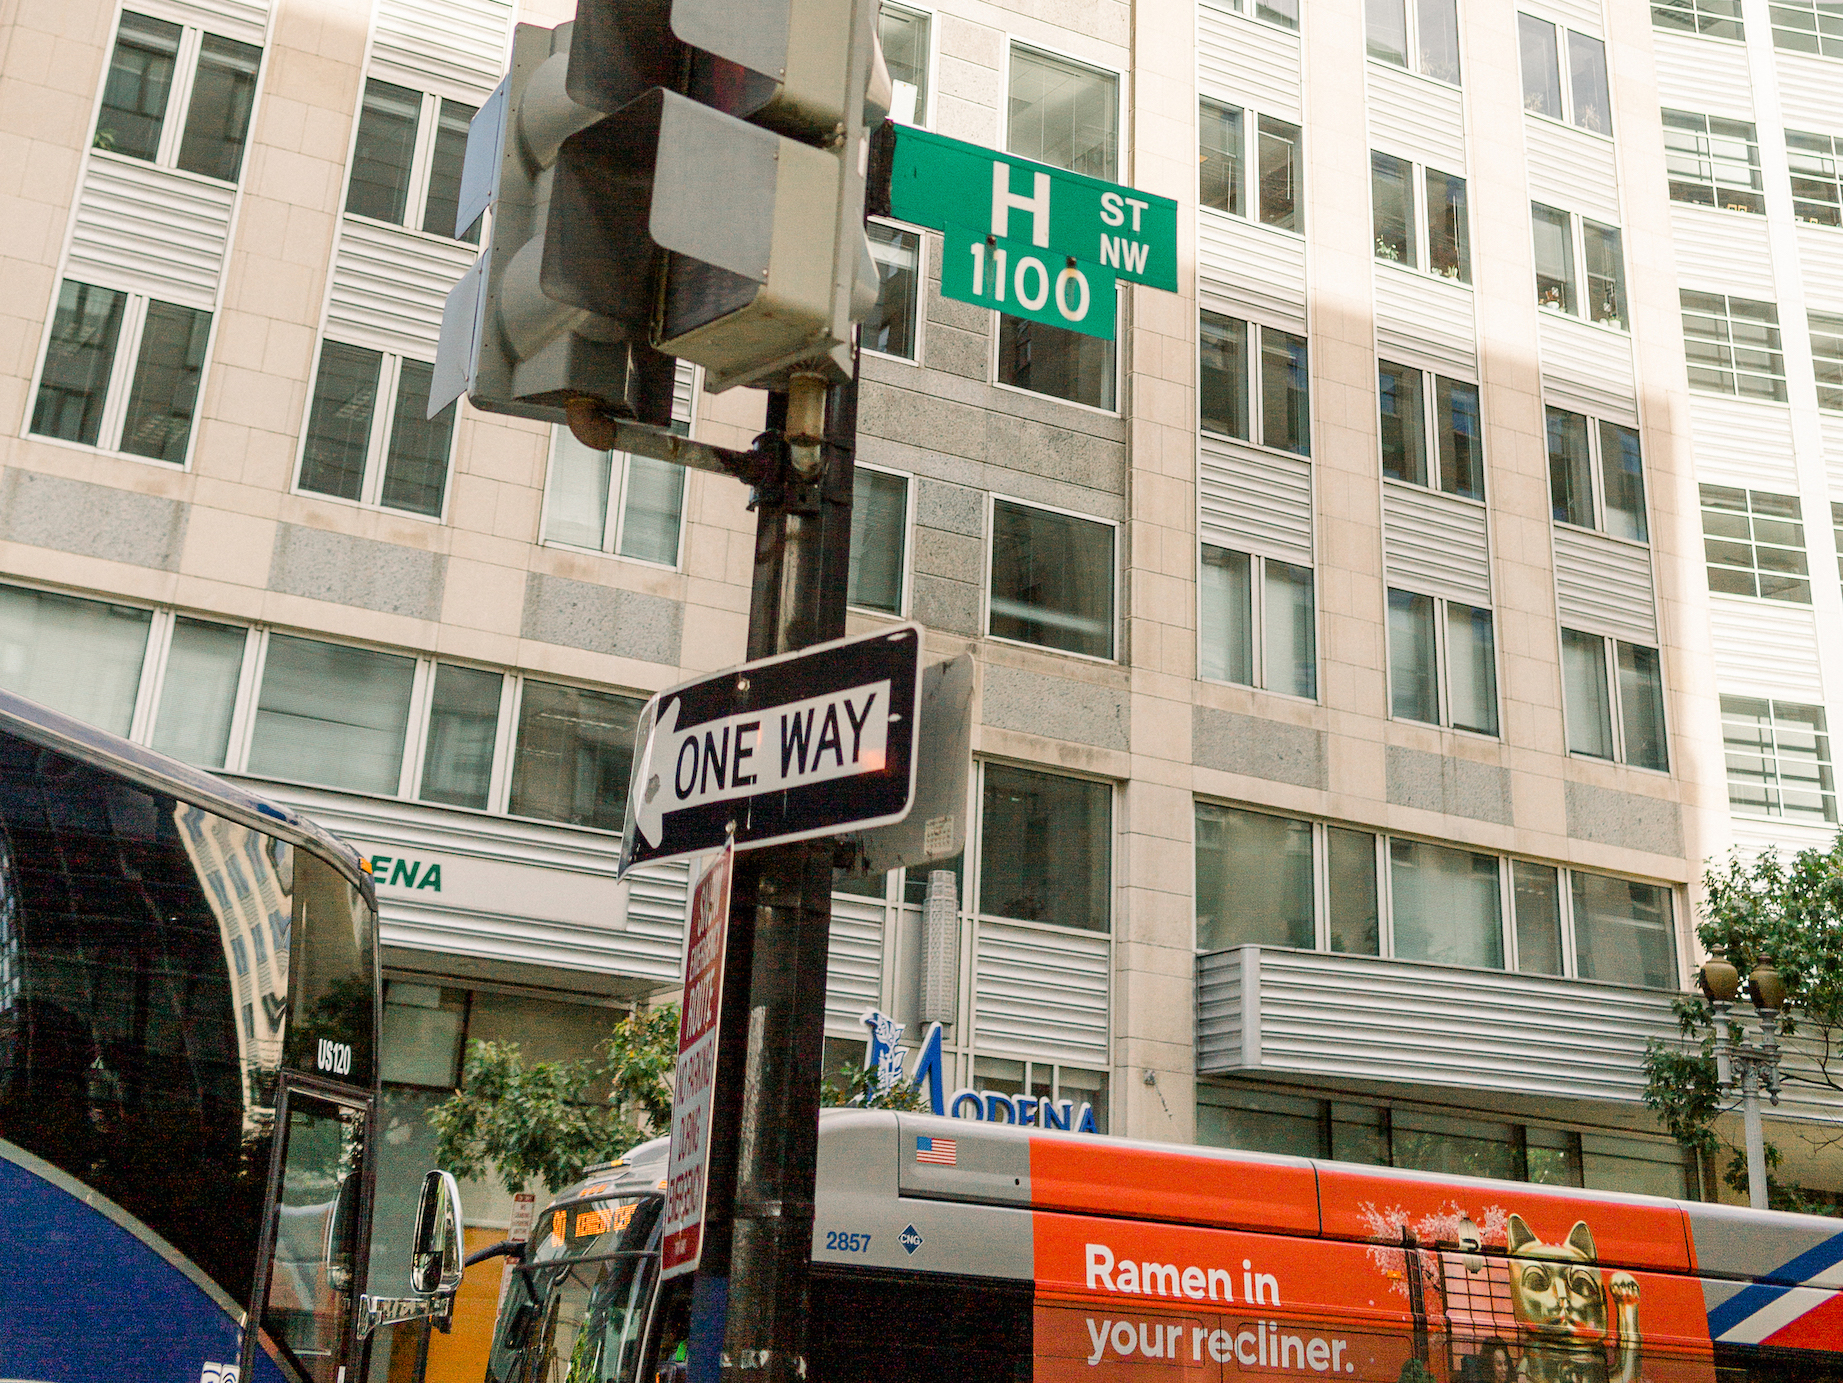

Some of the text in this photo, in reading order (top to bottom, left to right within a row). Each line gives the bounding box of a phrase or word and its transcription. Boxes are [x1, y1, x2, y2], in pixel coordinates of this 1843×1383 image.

[990, 160, 1051, 249] H
[1099, 191, 1149, 232] ST
[970, 242, 1091, 323] 1100
[1099, 233, 1150, 275] NW
[674, 692, 878, 802] ONE WAY
[685, 967, 716, 1042] ROUTE
[317, 1038, 352, 1076] US120
[825, 1230, 872, 1253] 2857
[899, 1233, 922, 1246] CNG
[1085, 1243, 1282, 1307] Ramen in
[1086, 1317, 1355, 1374] your recliner.
